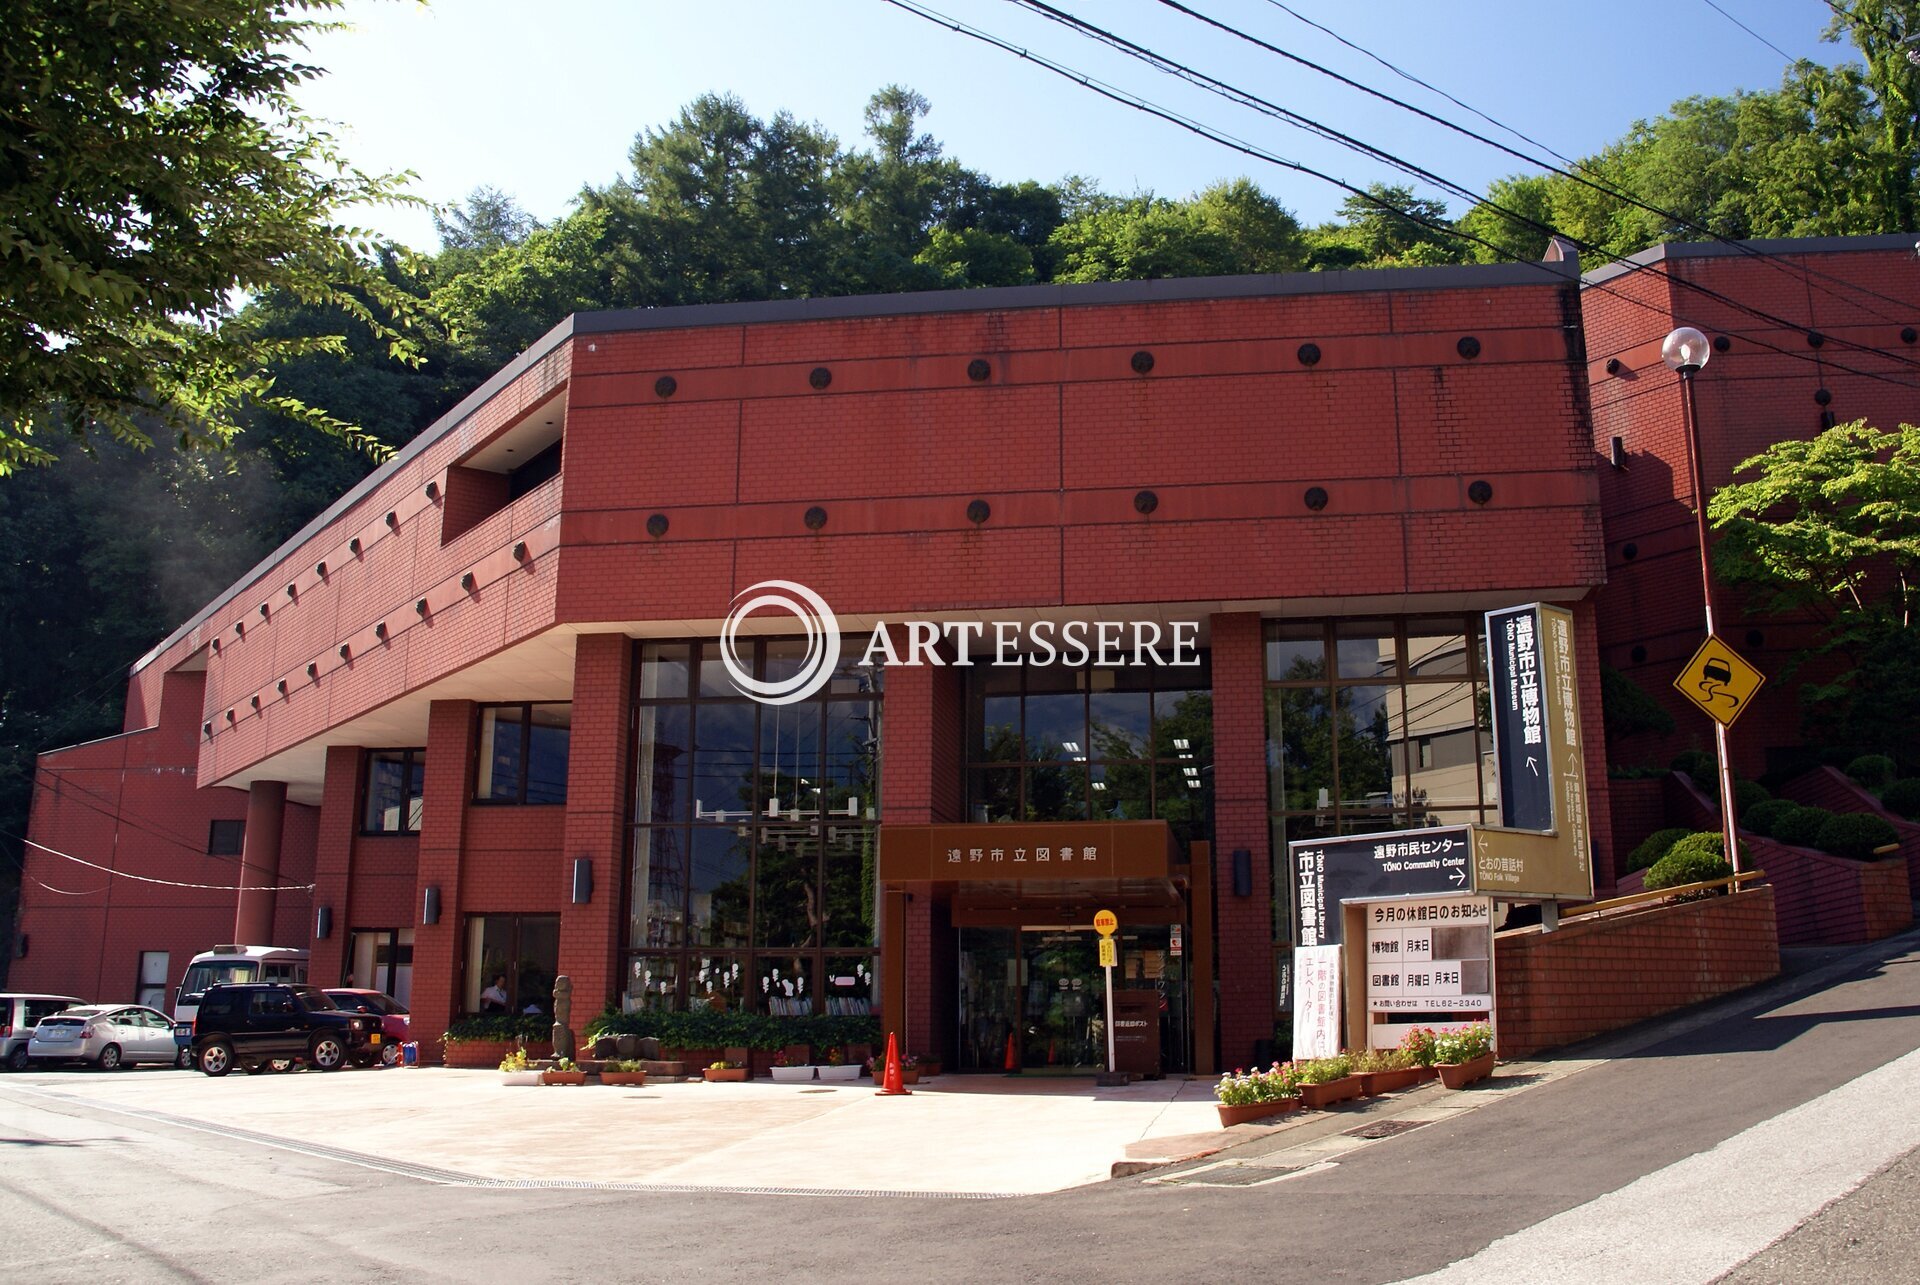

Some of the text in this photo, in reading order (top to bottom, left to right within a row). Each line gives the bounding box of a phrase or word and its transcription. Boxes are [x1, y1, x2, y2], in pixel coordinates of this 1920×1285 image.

[1508, 643, 1517, 677] Municipal
[1516, 615, 1541, 744] 遠野市立博物館
[1557, 619, 1576, 746] 遠野市立博物館
[1510, 678, 1518, 711] Museum
[948, 847, 1097, 863] 遠野市立図書館
[1374, 839, 1465, 859] 遠野市民センター
[1404, 859, 1440, 870] Community
[1442, 857, 1465, 867] Center
[1479, 856, 1523, 872] とおの昔話村
[1298, 850, 1317, 946] 市立図書館
[1317, 874, 1325, 910] Municipal
[1318, 911, 1326, 939] Library
[1375, 904, 1487, 922] 今月の休館日のお知らせ
[1372, 939, 1429, 953] 博物館 月末日
[1305, 957, 1314, 1023] エレベーター
[1372, 972, 1458, 987] 図書館 月曜日 月末日
